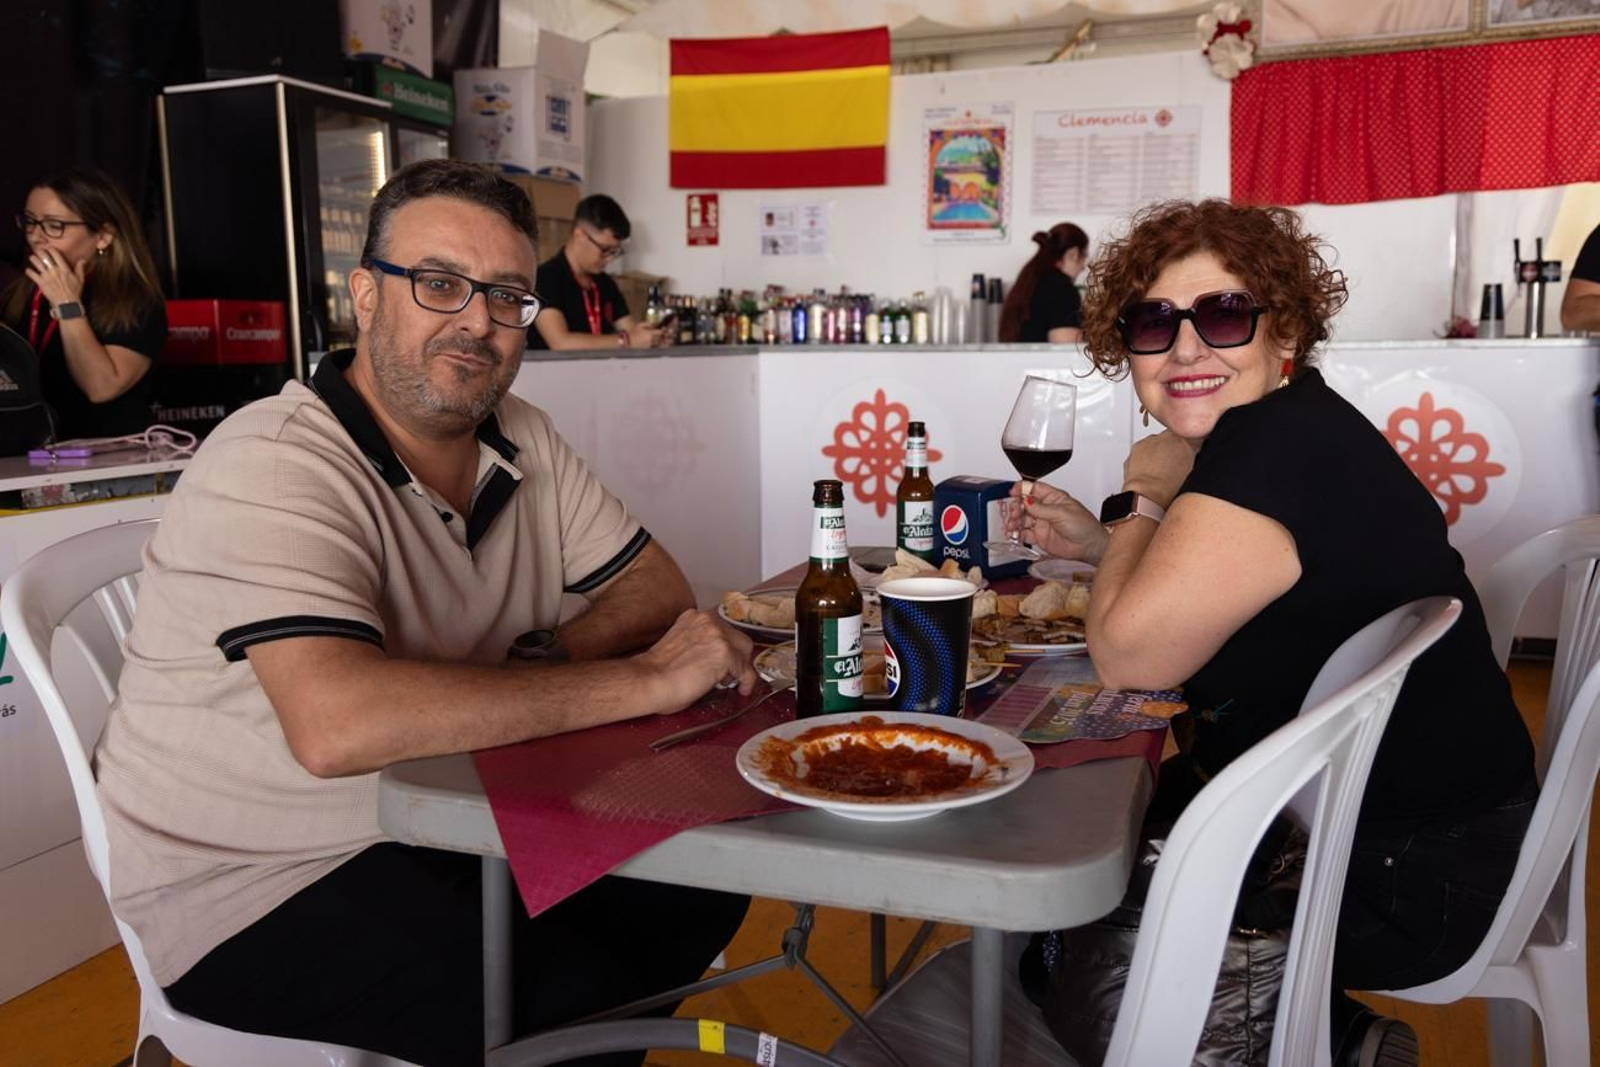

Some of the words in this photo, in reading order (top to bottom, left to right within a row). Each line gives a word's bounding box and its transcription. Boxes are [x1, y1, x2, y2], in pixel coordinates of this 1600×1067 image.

[393, 82, 449, 112] Heineken
[1057, 111, 1148, 128] Clemencia
[157, 405, 225, 421] HEINEKEN
[943, 547, 970, 559] pepsi
